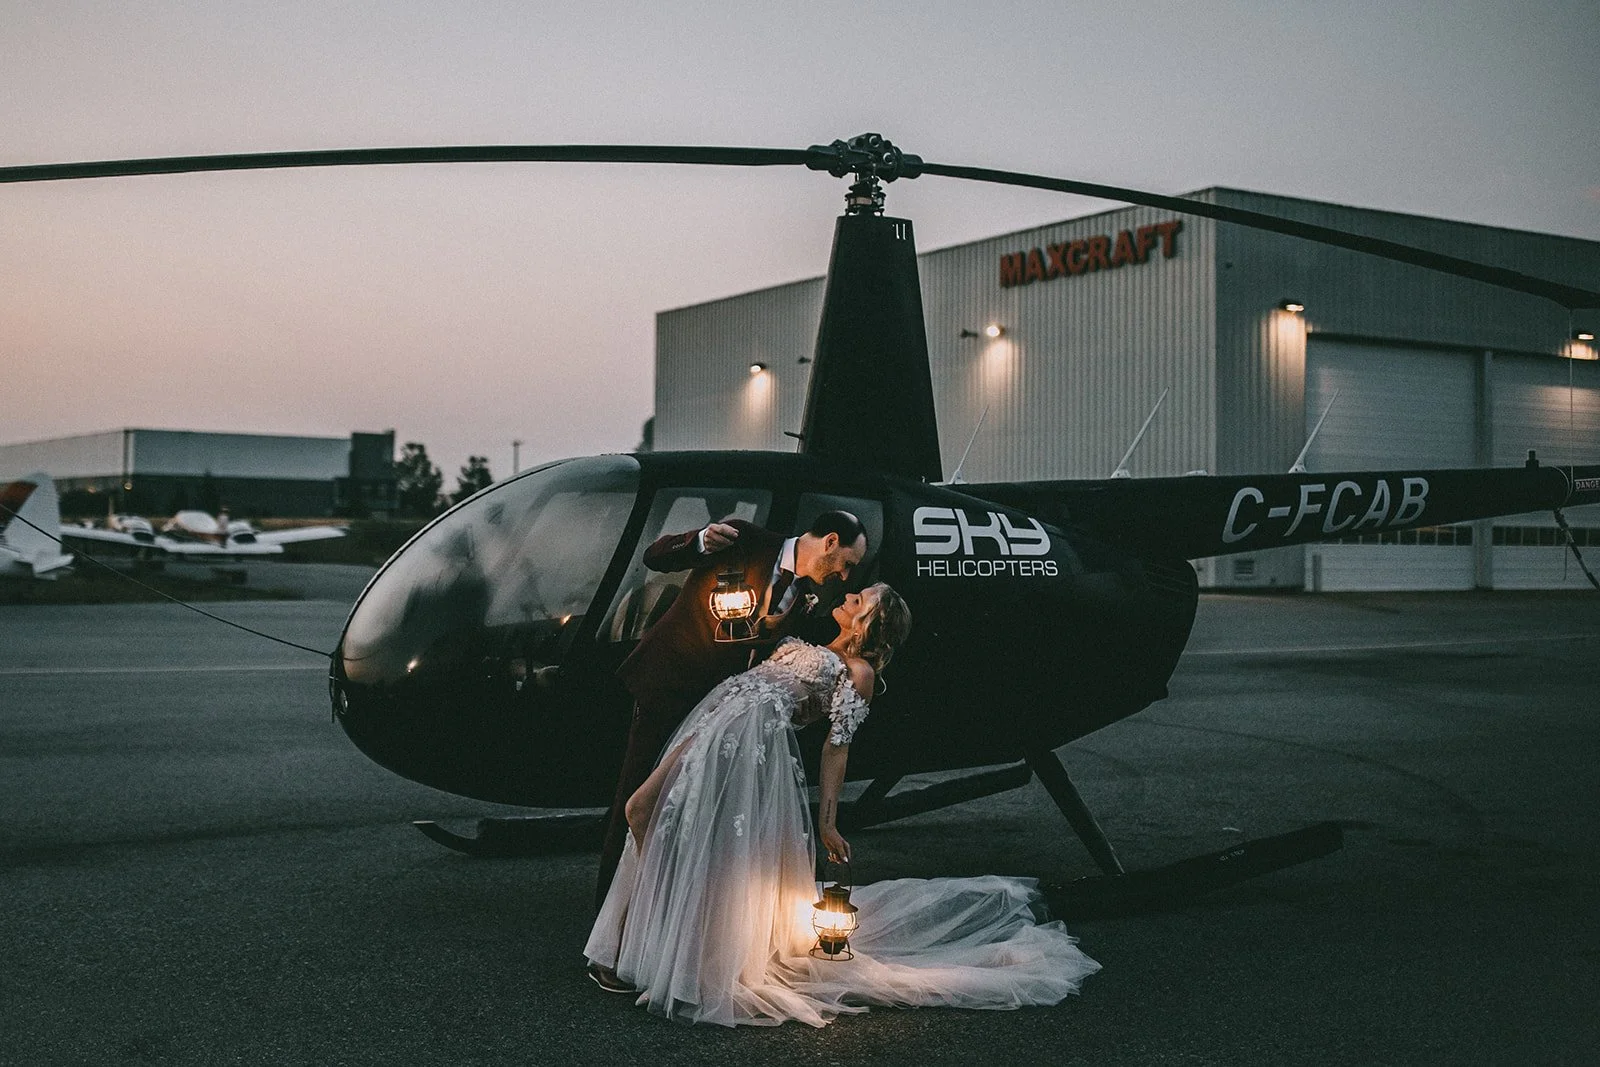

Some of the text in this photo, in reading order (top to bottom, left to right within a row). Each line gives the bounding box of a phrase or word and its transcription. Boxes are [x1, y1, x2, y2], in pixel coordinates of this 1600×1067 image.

[1000, 219, 1183, 288] MAXCRAFT
[913, 506, 1051, 556] SKY
[1222, 477, 1430, 543] C-FCAB
[916, 560, 1059, 577] HELICOPTERS
